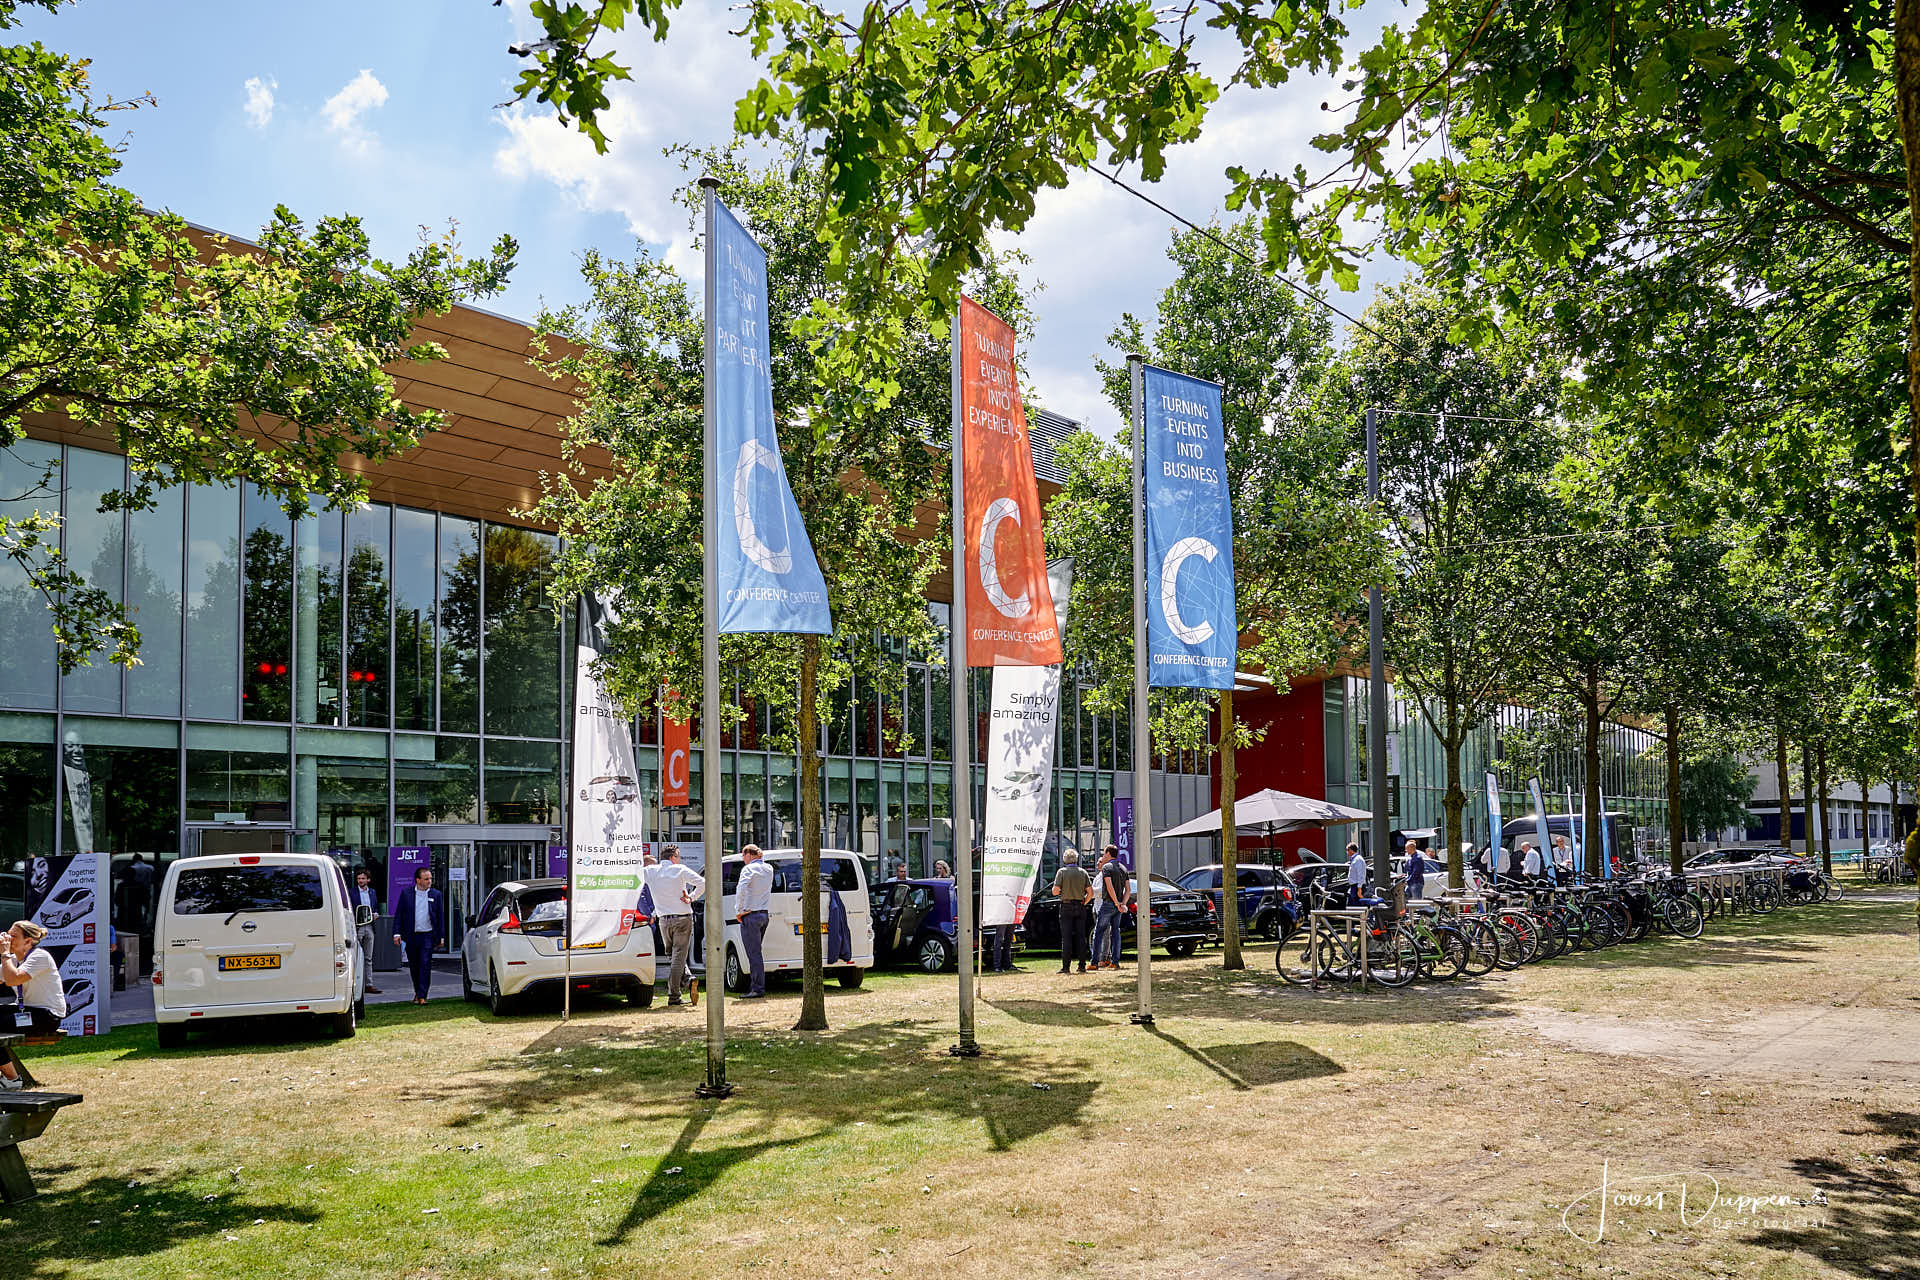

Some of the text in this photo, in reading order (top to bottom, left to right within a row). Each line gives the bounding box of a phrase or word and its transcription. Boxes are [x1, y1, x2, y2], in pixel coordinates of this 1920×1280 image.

[1161, 394, 1209, 419] TURNING
[1168, 418, 1208, 440] EVENTS
[1176, 441, 1203, 459] INTO
[1163, 461, 1218, 484] BUSINESS
[733, 438, 793, 575] C
[979, 497, 1032, 618] C
[726, 587, 788, 603] CONFERENCE
[1161, 536, 1218, 645] C
[973, 627, 1056, 643] CONFERENCE CENTER
[1153, 654, 1229, 668] CONFERENCE CENTER
[1010, 693, 1055, 708] Simply
[992, 709, 1053, 723] amazing.
[669, 749, 685, 789] C
[1013, 824, 1044, 834] Nieuwe
[608, 833, 641, 841] Nieuwe
[984, 835, 1043, 846] Nissan LEAF
[1118, 815, 1130, 865] J&T
[397, 850, 420, 860] J&T
[555, 849, 568, 859] J&
[576, 844, 641, 854] Nissan LEAF
[1008, 848, 1041, 857] Emission
[604, 858, 642, 866] Emission
[68, 869, 96, 877] Together
[68, 960, 96, 968] Together
[228, 957, 276, 967] NX-563-K
